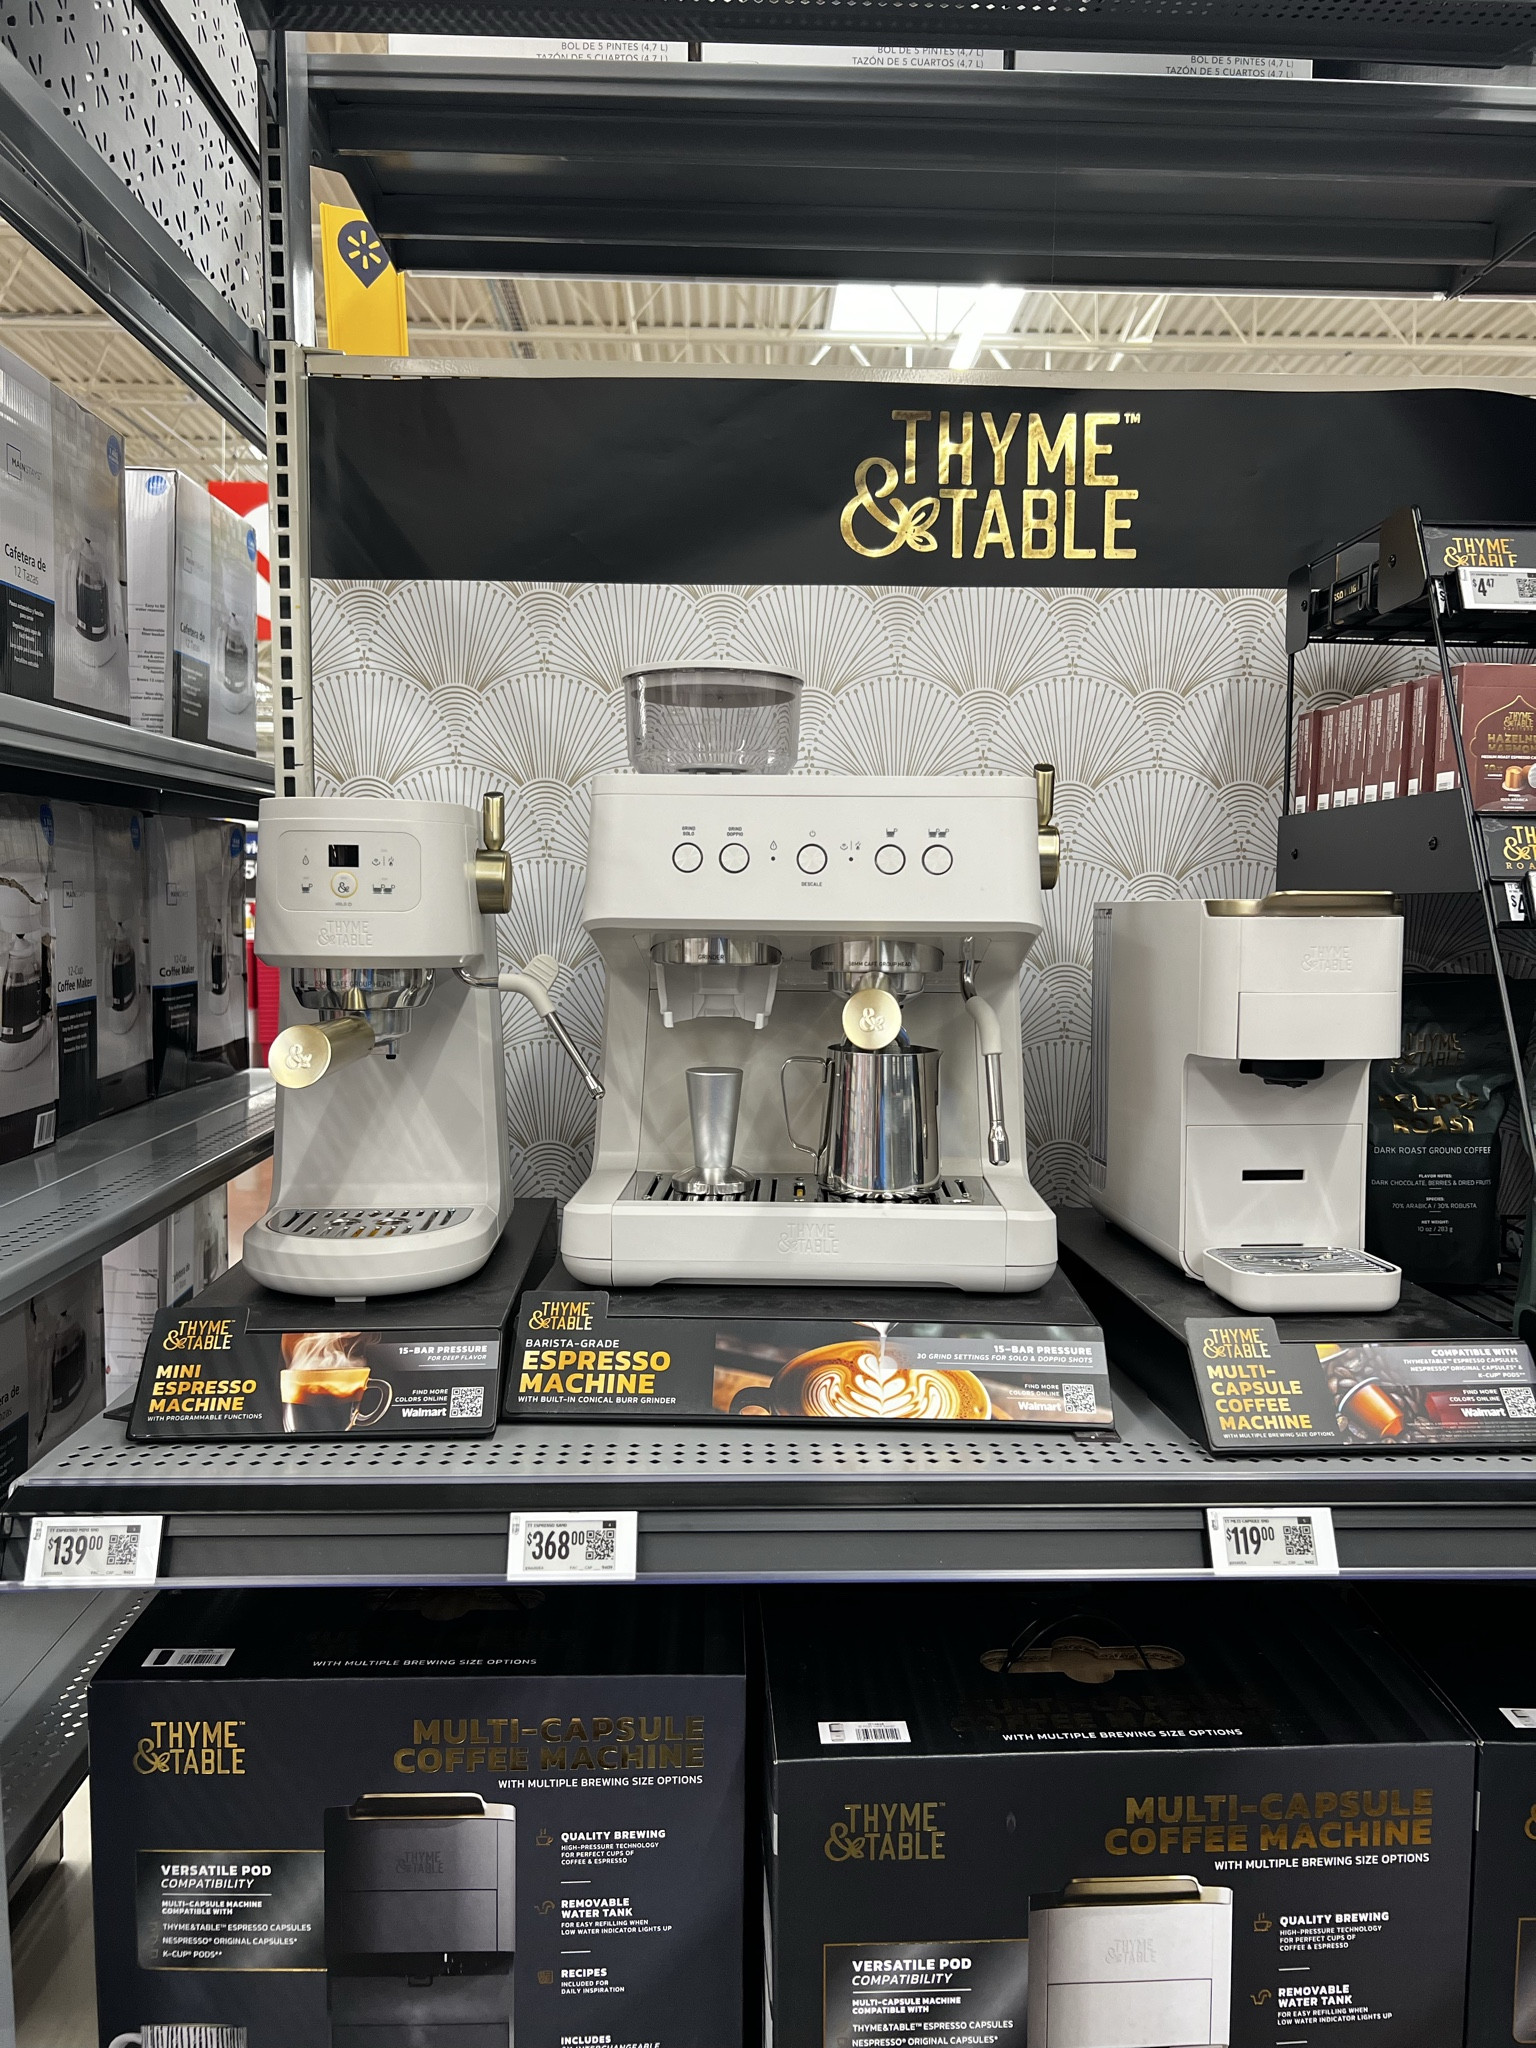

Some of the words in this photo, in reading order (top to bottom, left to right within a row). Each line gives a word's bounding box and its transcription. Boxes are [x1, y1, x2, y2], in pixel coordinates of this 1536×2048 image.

[561, 41, 580, 51] BOL
[582, 42, 595, 51] DE
[598, 42, 604, 51] 5
[606, 42, 639, 51] PINTES
[641, 43, 657, 52] (4,7
[660, 43, 668, 53] L)
[852, 56, 884, 66] TAZÓN
[887, 57, 899, 66] DE
[902, 57, 908, 66] 5
[910, 57, 955, 67] CUARTOS
[956, 59, 973, 68] (4,7
[976, 60, 984, 69] L)
[4, 543, 36, 568] Cafetera
[37, 557, 47, 572] de
[14, 565, 22, 579] 12
[22, 568, 39, 585] Tazas
[180, 622, 199, 640] Cafetera
[326, 920, 369, 934] THYME
[159, 966, 181, 978] Coffee
[181, 965, 195, 975] Maker
[57, 980, 76, 993] Coffee
[76, 976, 93, 991] Maker
[1374, 1146, 1396, 1154] DARK
[1398, 1146, 1427, 1154] ROAST
[1428, 1146, 1462, 1154] GROUND
[787, 1223, 836, 1239] THYME
[399, 1346, 435, 1355] 15-BAR
[437, 1345, 488, 1353] PRESSURE
[525, 1339, 620, 1348] BARISTA-GRADE
[993, 1345, 1034, 1354] 15-BAR
[1036, 1346, 1092, 1355] PRESSURE
[1431, 1348, 1492, 1357] COMPATIBLE
[1492, 1348, 1518, 1356] WITH
[522, 1350, 671, 1371] ESPRESSO
[155, 1364, 201, 1379] MINI
[1206, 1365, 1276, 1379] MULTI-
[152, 1380, 257, 1396] ESPRESSO
[519, 1373, 656, 1394] MACHINE
[1211, 1380, 1303, 1396] CAPSULE
[148, 1397, 245, 1412] MACHINE
[518, 1395, 539, 1403] WITH
[577, 1396, 614, 1404] CONICAL
[615, 1396, 639, 1404] BURR
[1017, 1401, 1062, 1411] Walmart
[1215, 1398, 1292, 1413] COFFEE
[400, 1404, 447, 1417] Walmart
[1460, 1408, 1508, 1417] Walmart
[1219, 1415, 1313, 1430] MACHINE
[414, 1716, 705, 1744] MULTI-CAPSULE
[1037, 1732, 1097, 1740] MULTIPLE
[1099, 1730, 1157, 1738] BREWING
[1188, 1728, 1243, 1736] OPTIONS
[393, 1747, 529, 1774] COFFEE
[540, 1744, 705, 1772] MACHINE
[498, 1779, 525, 1789] WITH
[527, 1778, 578, 1788] MULTIPLE
[581, 1777, 629, 1787] BREWING
[632, 1776, 654, 1786] SIZE
[657, 1775, 703, 1785] OPTIONS
[1126, 1789, 1433, 1823] MULTI-CAPSULE
[561, 1831, 611, 1843] QUALITY
[614, 1829, 666, 1840] BREWING
[1104, 1825, 1248, 1855] COFFEE
[1260, 1819, 1432, 1850] MACHINE
[561, 1843, 614, 1851] HIGH-PRESSURE
[1214, 1860, 1243, 1870] WITH
[1245, 1858, 1299, 1869] MULTIPLE
[1301, 1856, 1353, 1867] BREWING
[1355, 1855, 1379, 1865] SIZE
[1381, 1853, 1430, 1864] OPTIONS
[161, 1865, 238, 1876] VERSATILE
[241, 1865, 272, 1876] POD
[161, 1878, 255, 1889] COMPATIBILITY
[561, 1898, 630, 1908] REMOVABLE
[561, 1909, 600, 1919] WATER
[602, 1907, 633, 1917] TANK
[1279, 1914, 1332, 1927] QUALITY
[1335, 1911, 1389, 1923] BREWING
[852, 1959, 935, 1972] VERSATILE
[939, 1958, 972, 1970] POD
[561, 1968, 607, 1978] RECIPES
[852, 1973, 953, 1986] COMPATIBILITY
[1278, 1984, 1350, 1997] REMOVABLE
[1278, 1997, 1318, 2008] WATER
[1320, 1995, 1353, 2005] TANK
[561, 2035, 611, 2045] INCLUDES
